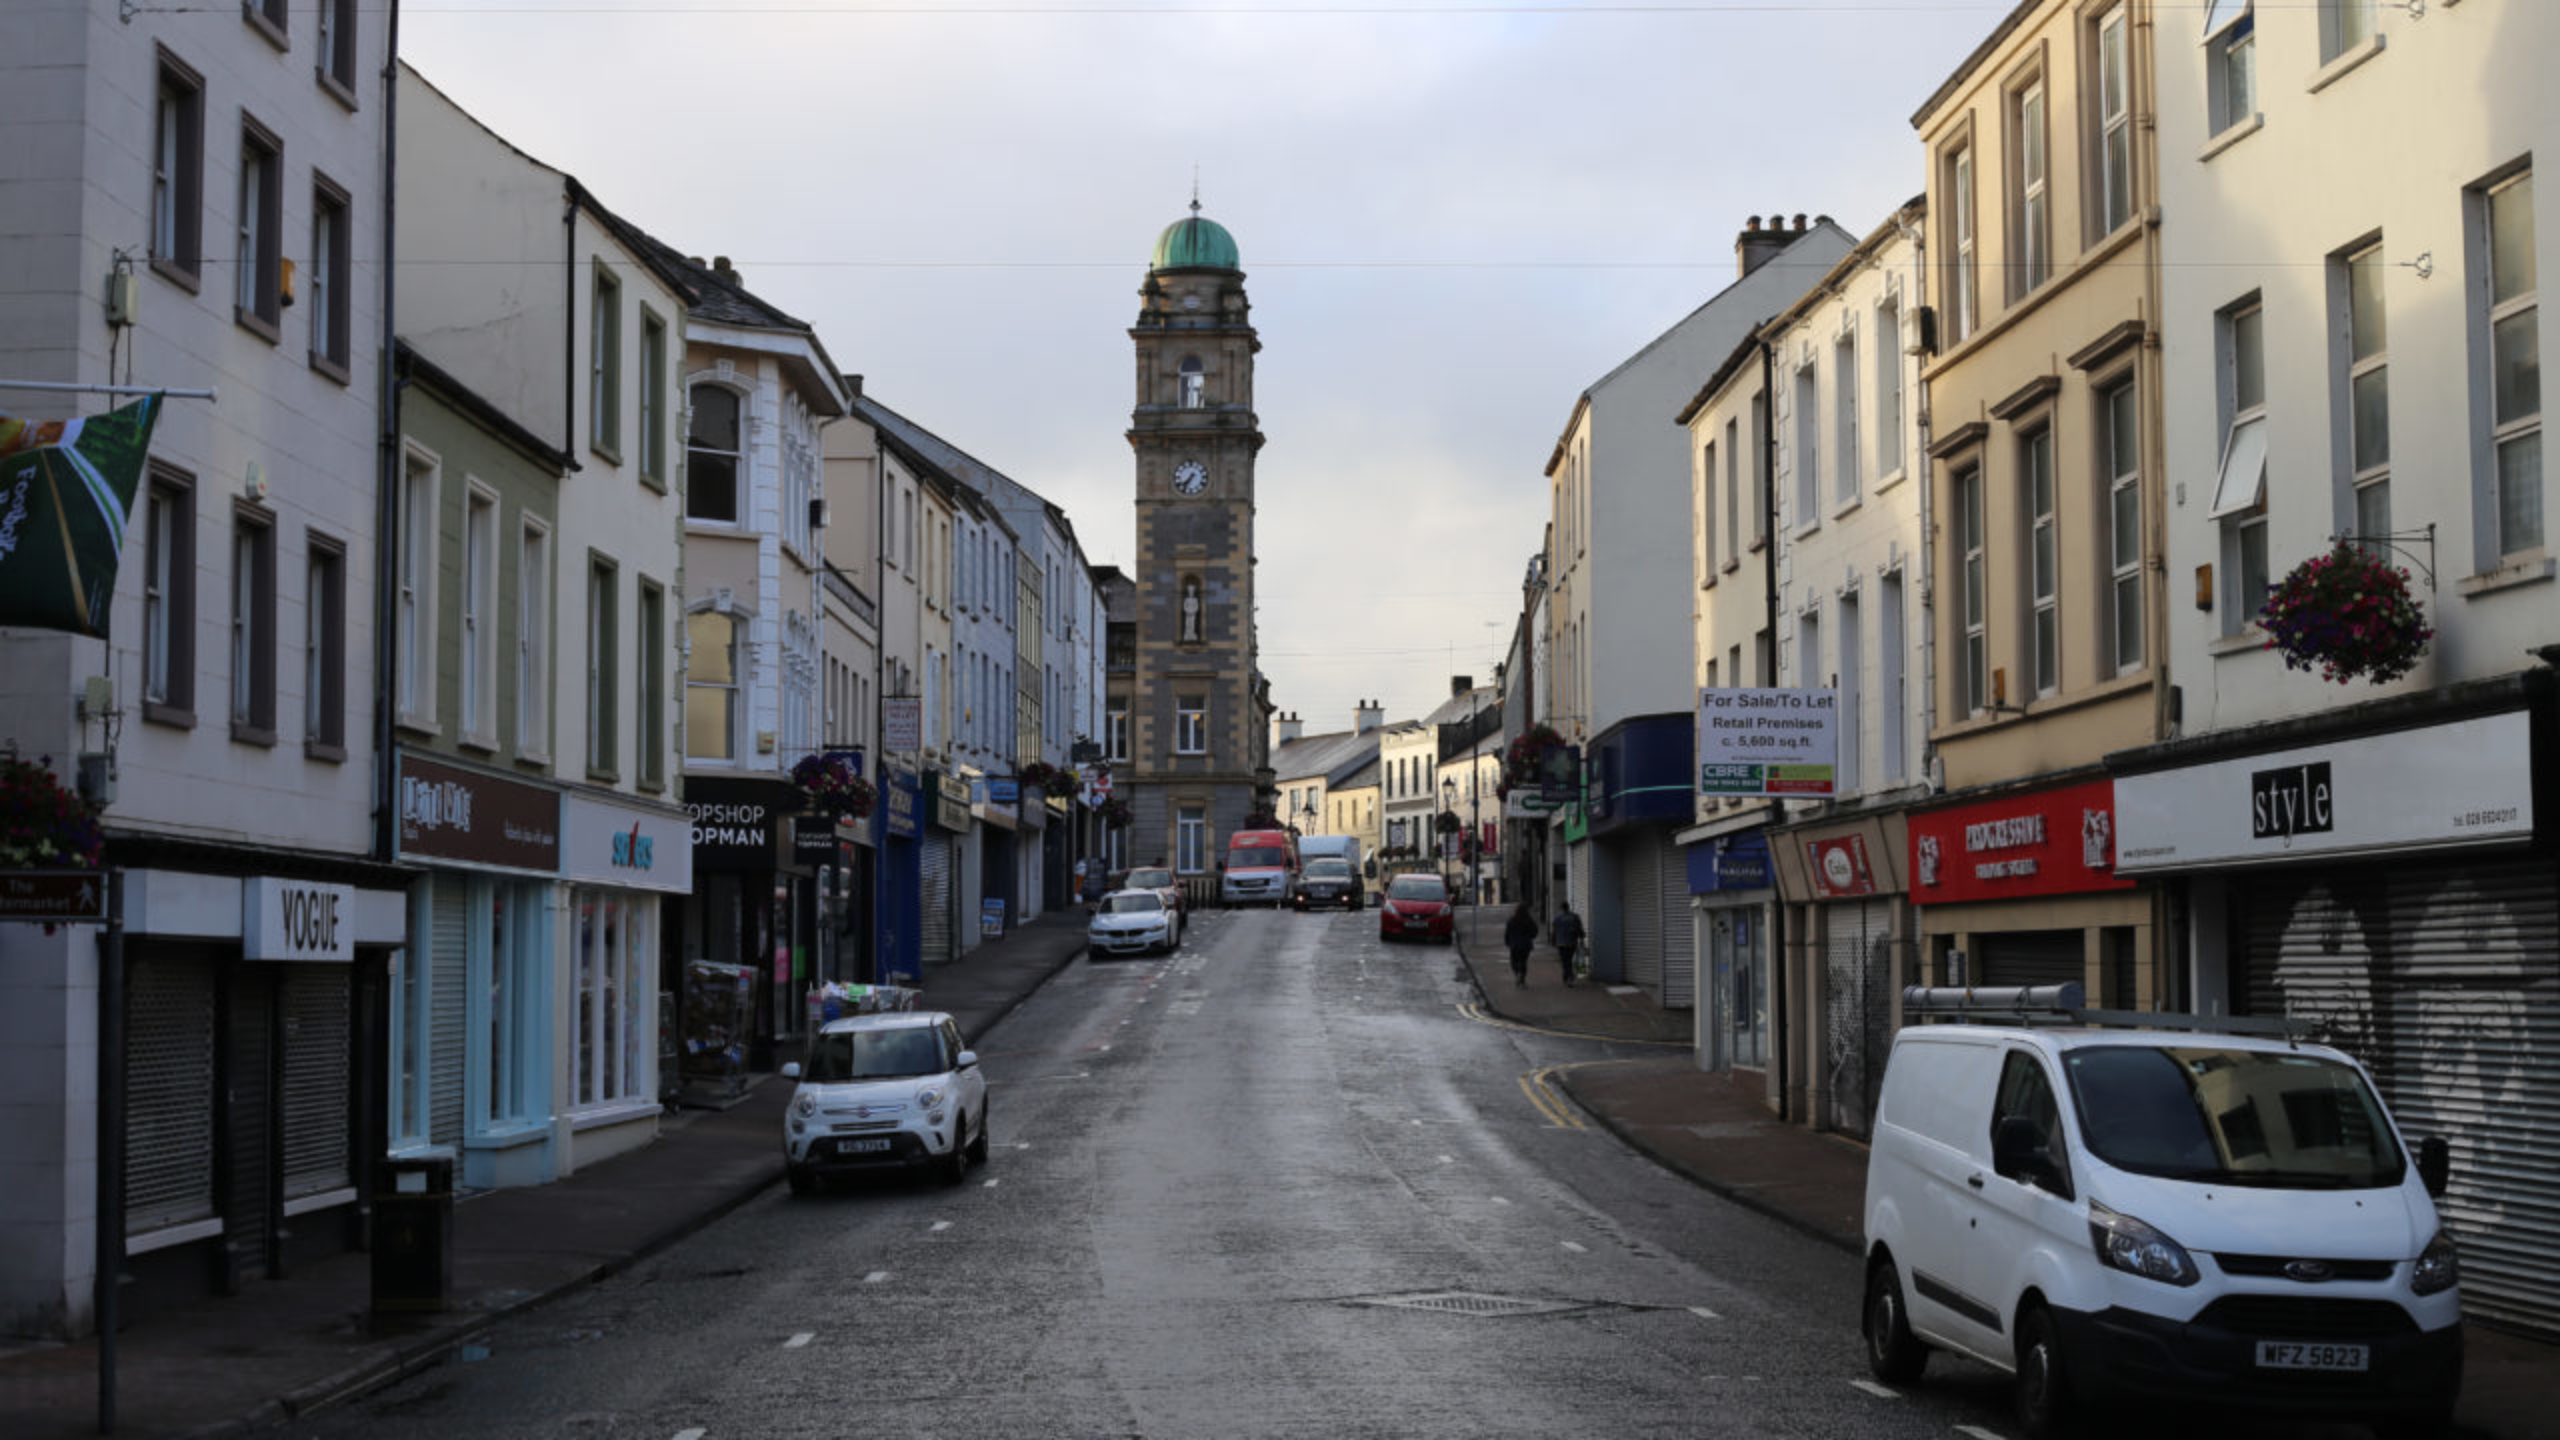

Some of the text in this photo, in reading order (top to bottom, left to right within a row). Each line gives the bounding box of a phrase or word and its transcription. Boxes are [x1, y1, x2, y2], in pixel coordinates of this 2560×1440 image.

[1704, 693, 1834, 708] For Sale/To Let
[1713, 716, 1824, 729] Retail Premises
[1704, 765, 1749, 778] CBRE
[684, 803, 765, 823] OPSHOP
[2254, 766, 2329, 848] style
[690, 827, 765, 846] OPMAN
[281, 889, 339, 951] VOGUE
[2310, 1346, 2361, 1367] 5823
